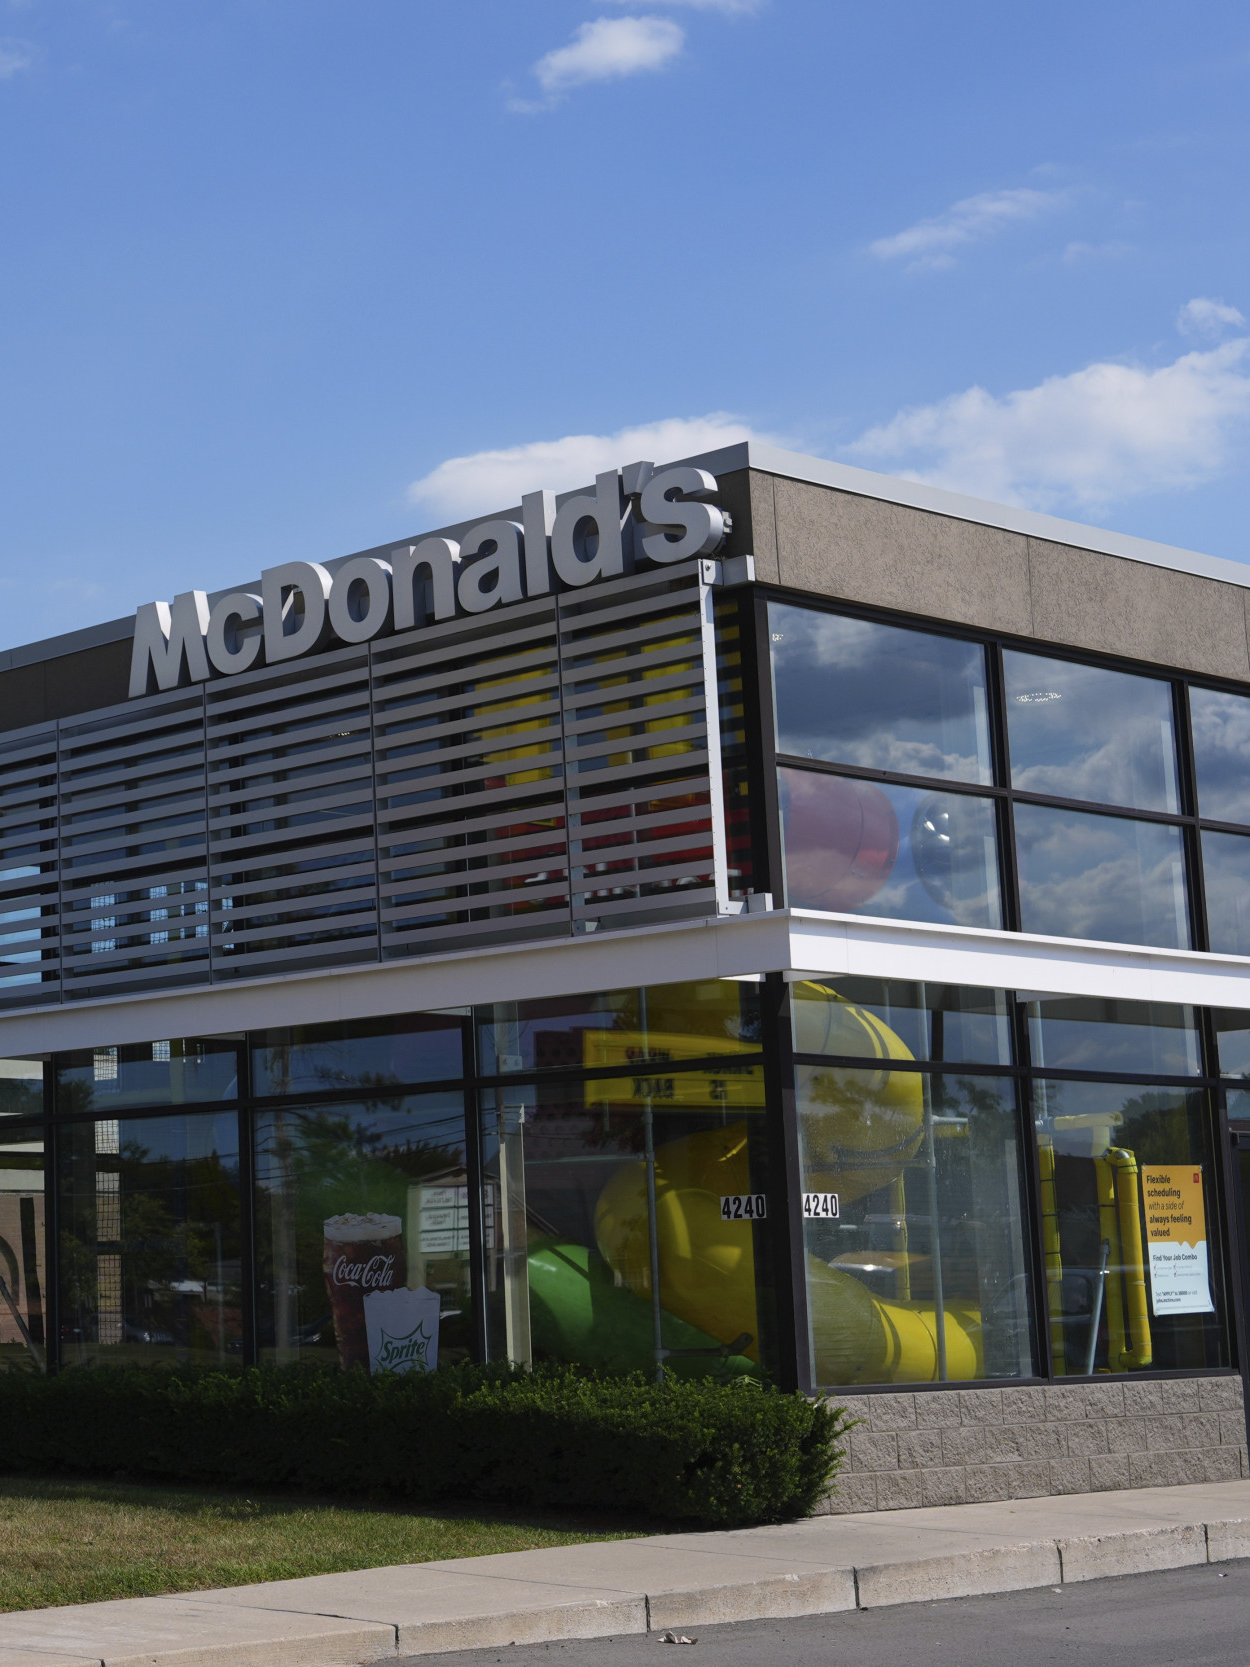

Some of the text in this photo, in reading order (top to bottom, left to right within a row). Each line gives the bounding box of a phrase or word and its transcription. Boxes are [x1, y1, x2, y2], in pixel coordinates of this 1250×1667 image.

[128, 461, 725, 698] McDonald's
[1146, 1174, 1171, 1184] Flexible
[1147, 1187, 1181, 1199] scheduling
[721, 1195, 766, 1219] 4240
[804, 1194, 839, 1217] 4240
[1149, 1201, 1160, 1210] with
[1165, 1201, 1177, 1210] side
[1178, 1200, 1185, 1210] of
[1149, 1213, 1192, 1225] always feeling
[1150, 1228, 1171, 1237] valued
[333, 1254, 395, 1288] Coca-Cola
[381, 1338, 426, 1364] Sprite
